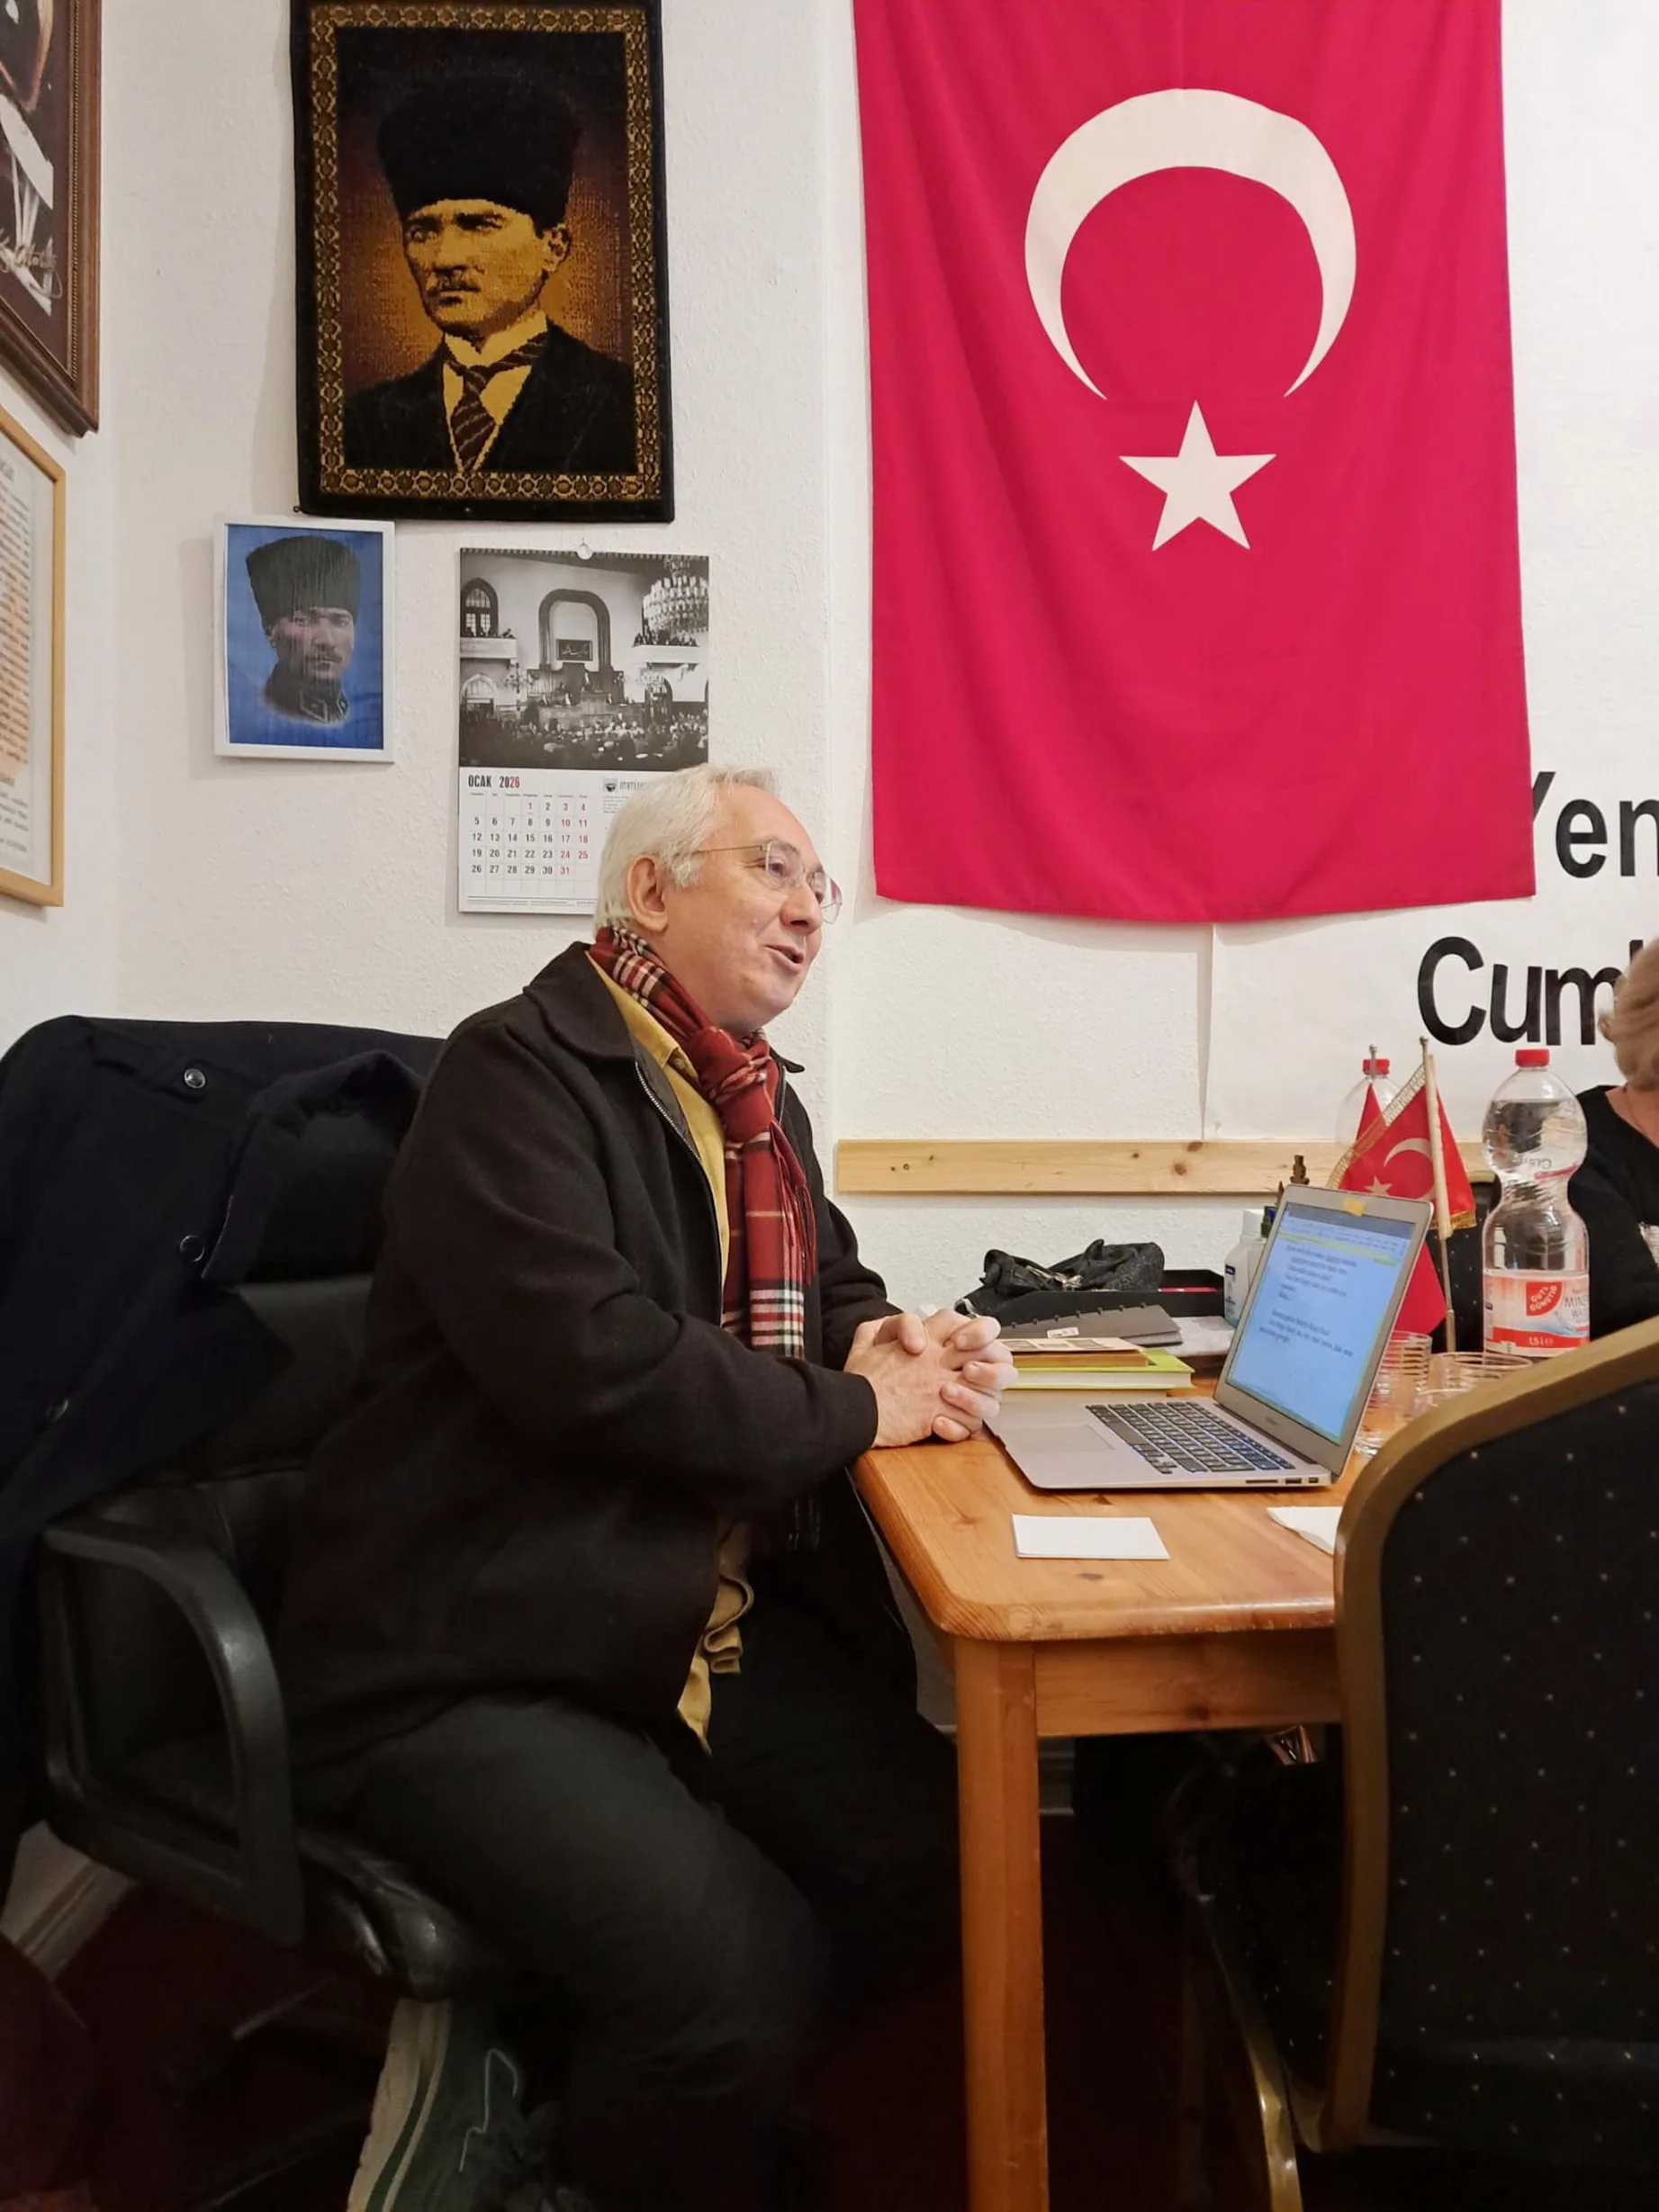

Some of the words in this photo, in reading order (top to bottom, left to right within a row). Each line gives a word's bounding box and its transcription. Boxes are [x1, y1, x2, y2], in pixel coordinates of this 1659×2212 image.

[467, 775, 492, 788] OCAK
[499, 776, 520, 789] 2026
[561, 818, 572, 827] 10
[578, 819, 588, 828] 11
[472, 832, 482, 842] 12
[490, 832, 500, 842] 13
[508, 832, 518, 842] 14
[526, 833, 536, 843] 15
[543, 833, 554, 843] 16
[561, 834, 571, 843] 17
[472, 848, 482, 858] 19
[489, 849, 500, 859] 20
[507, 849, 517, 859] 21
[524, 849, 536, 859] 22
[542, 849, 553, 859] 23
[560, 850, 571, 859] 24
[578, 850, 589, 859] 25
[471, 864, 482, 874] 26
[489, 864, 500, 874] 27
[525, 865, 536, 875] 29
[542, 865, 554, 876] 30
[560, 866, 570, 876] 31
[1418, 936, 1644, 1046] Cum
